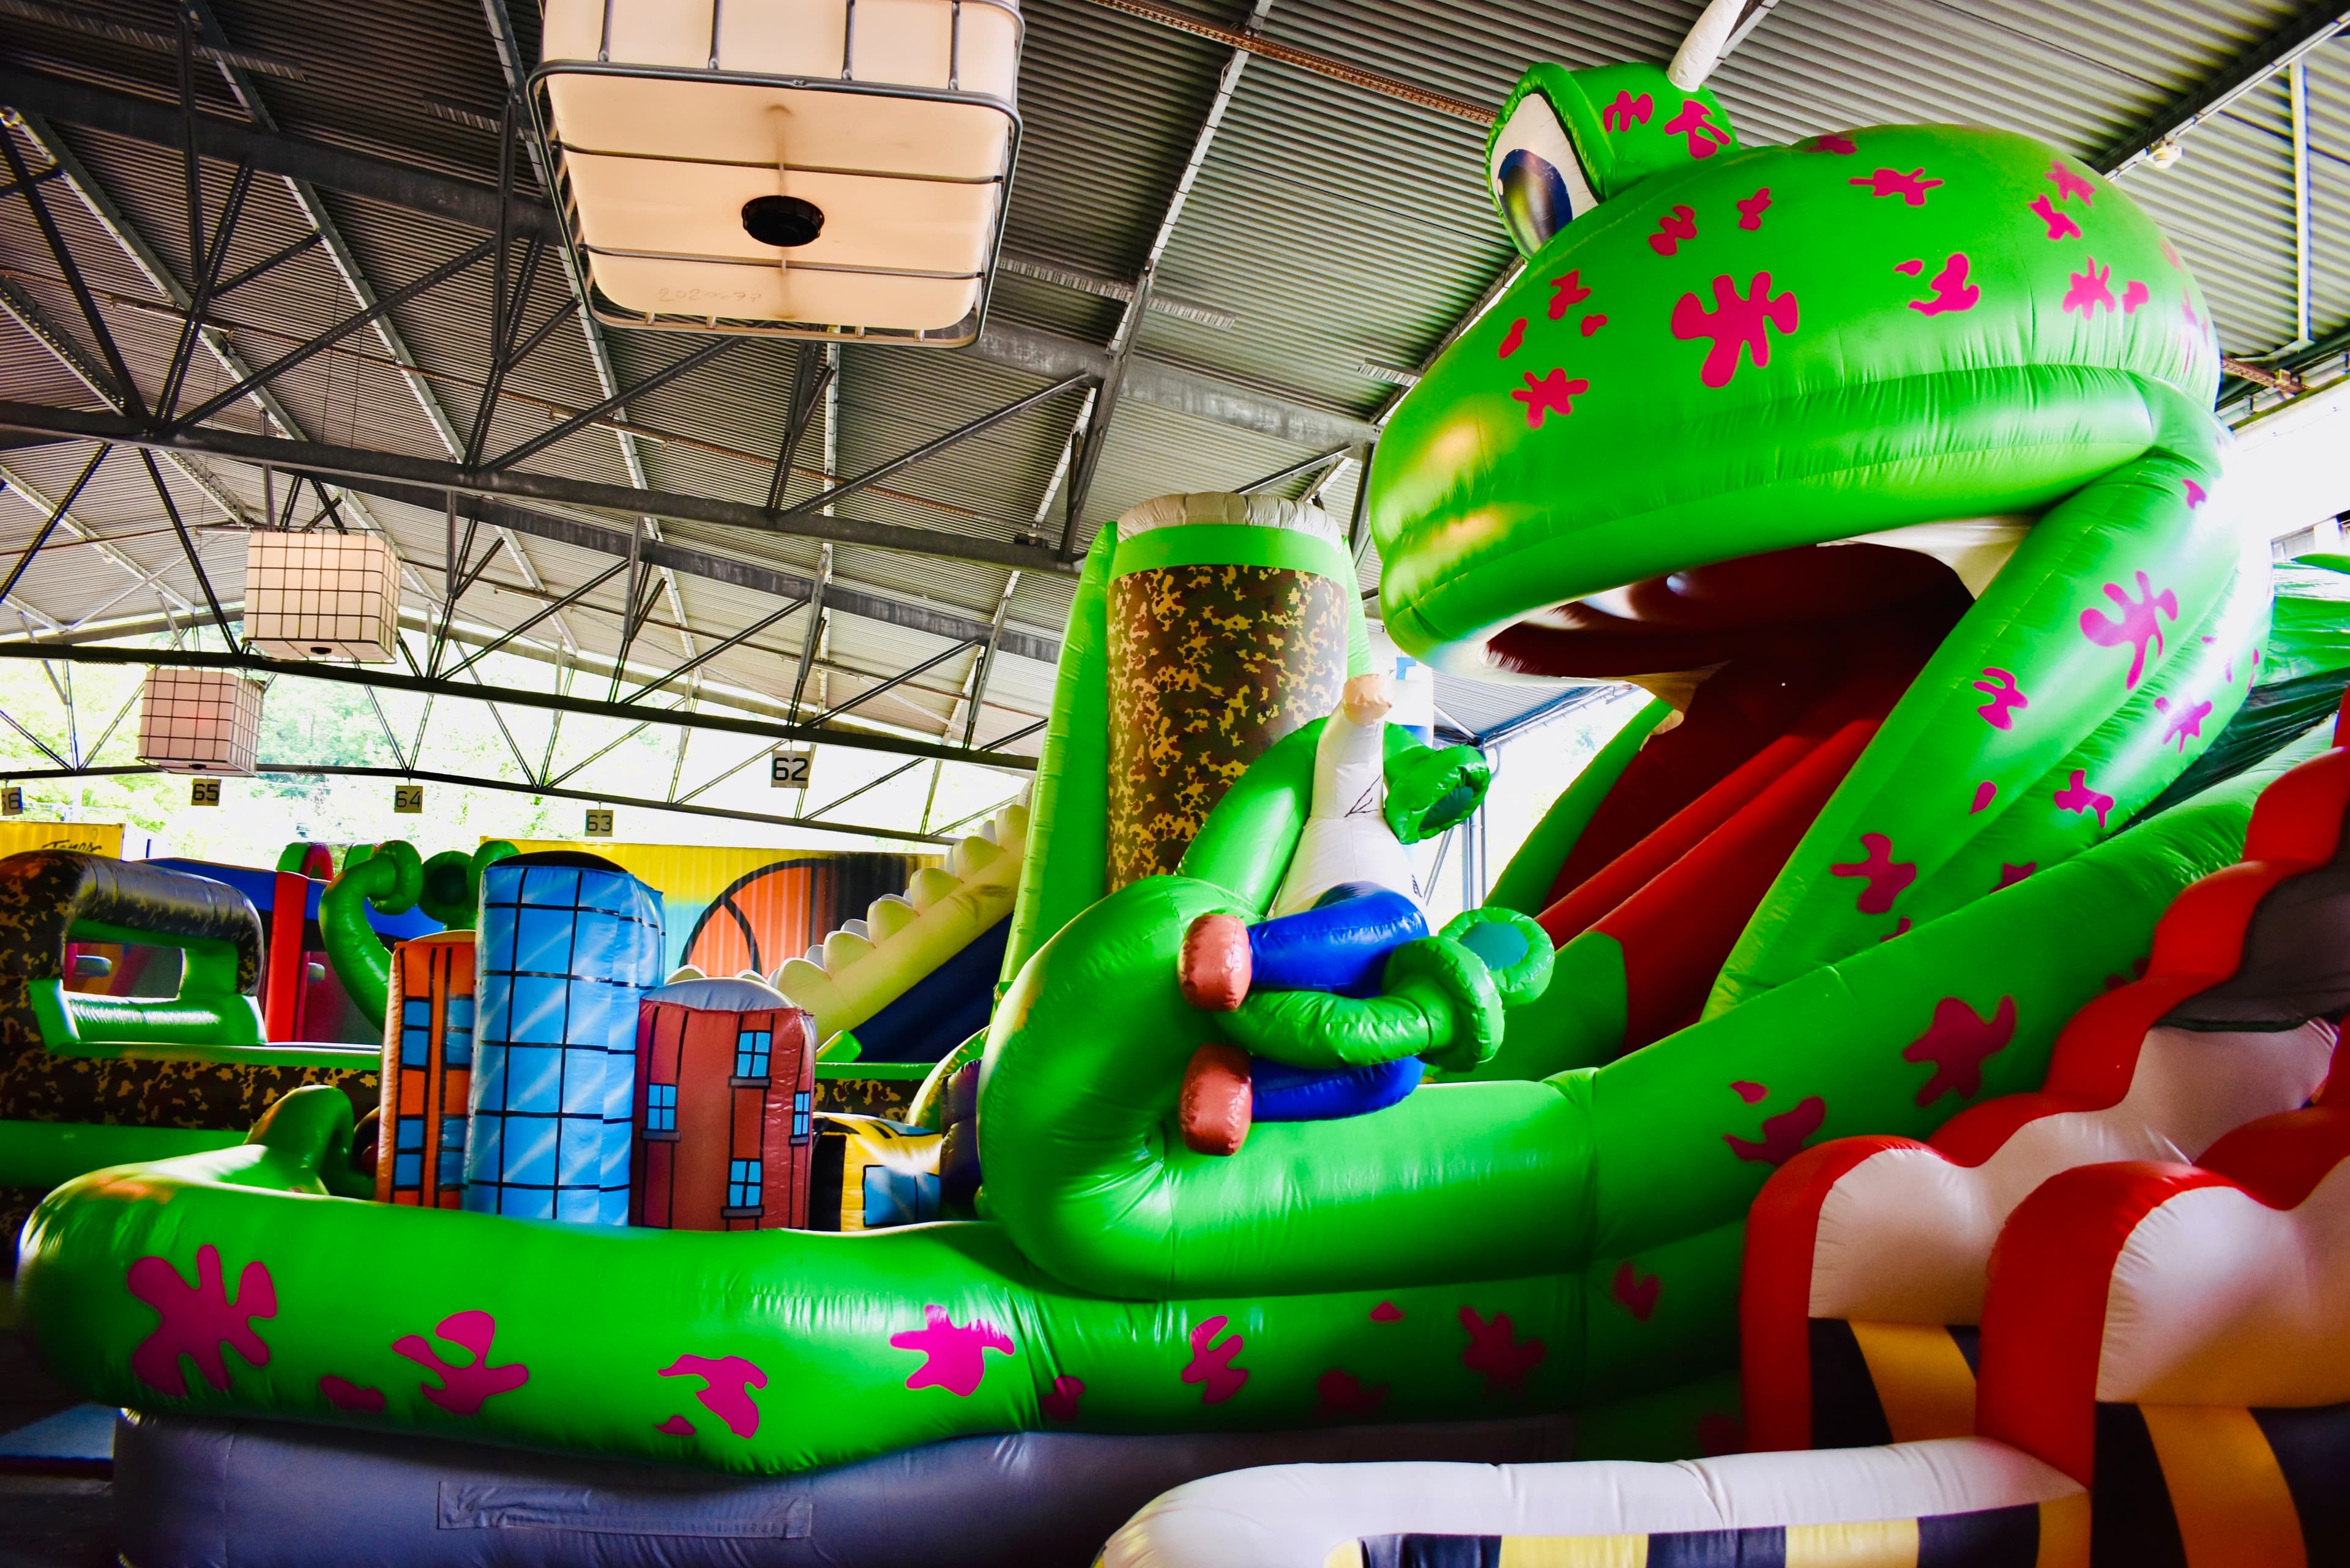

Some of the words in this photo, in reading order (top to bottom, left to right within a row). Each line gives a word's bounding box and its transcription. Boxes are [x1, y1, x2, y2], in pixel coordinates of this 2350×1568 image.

[774, 758, 808, 780] 62
[193, 783, 219, 801] 65
[396, 791, 421, 808] 64
[588, 815, 611, 832] 63
